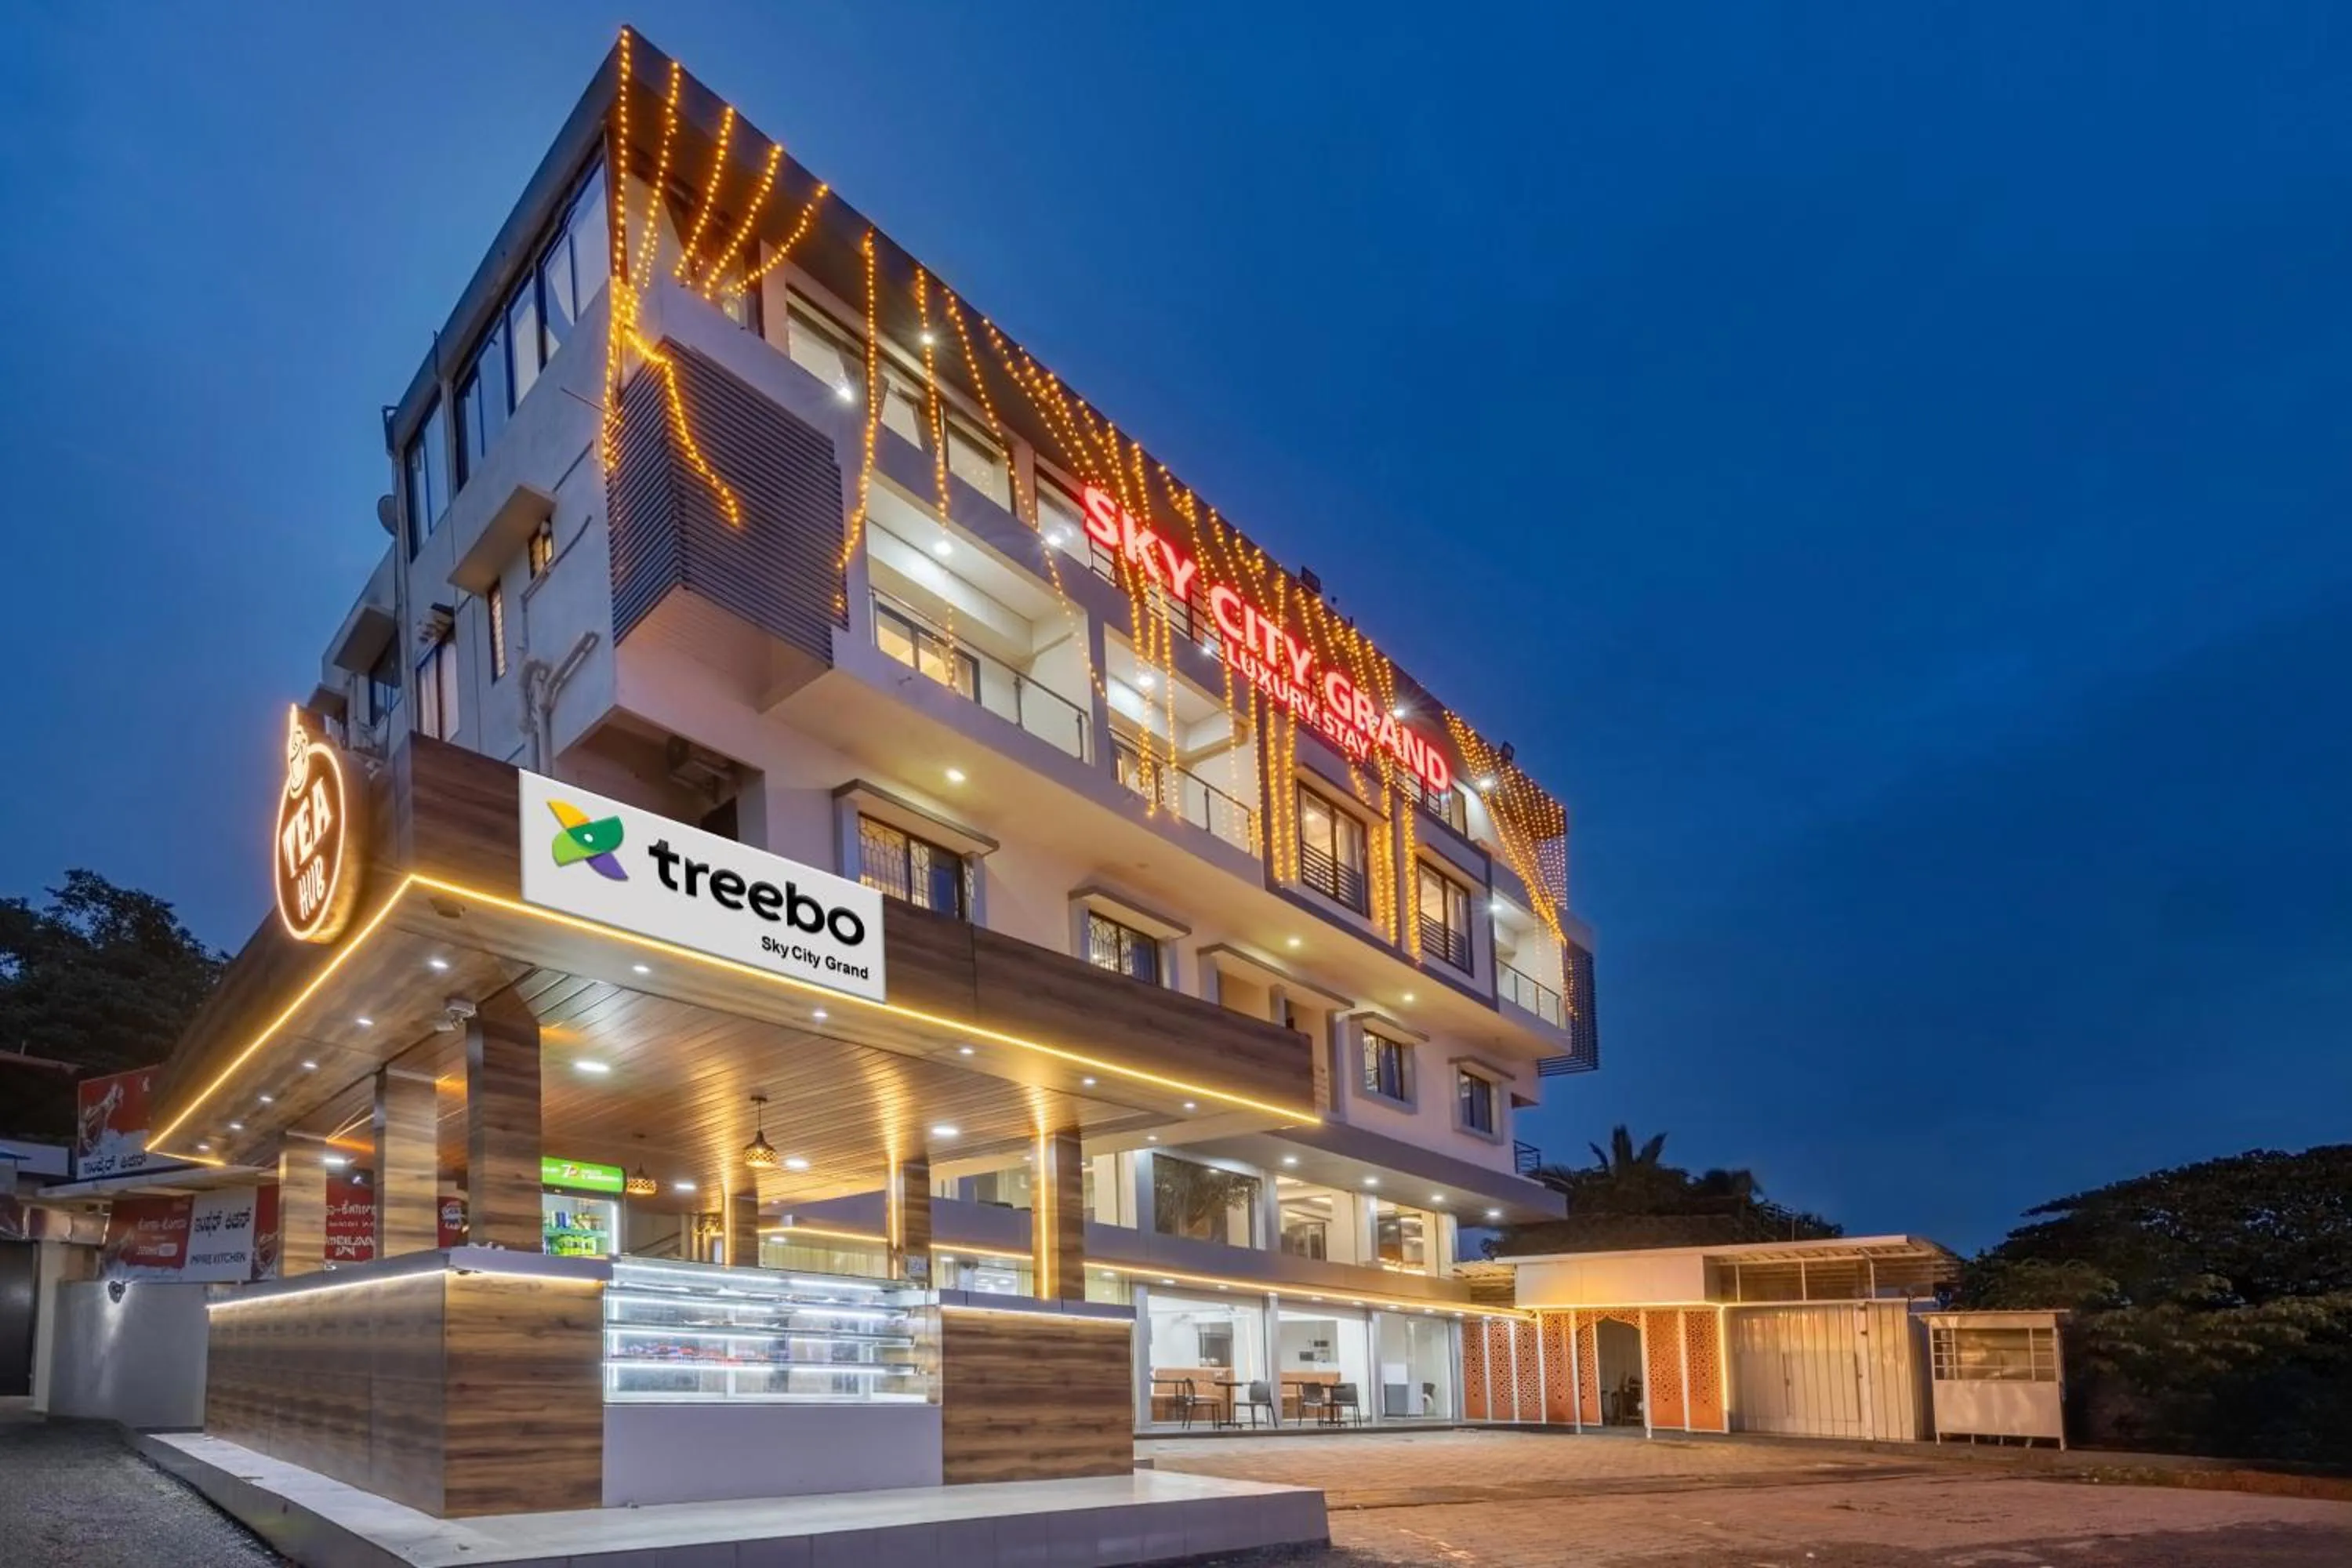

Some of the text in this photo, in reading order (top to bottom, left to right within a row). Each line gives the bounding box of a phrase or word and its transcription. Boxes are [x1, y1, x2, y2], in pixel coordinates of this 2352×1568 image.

[1082, 485, 1450, 790] SKY CITY GRAND
[1224, 638, 1369, 759] LUXURY STAY
[282, 777, 332, 878] TEA
[297, 855, 325, 920] HUB
[648, 839, 866, 946] treebo
[761, 935, 869, 979] Sky City Grand
